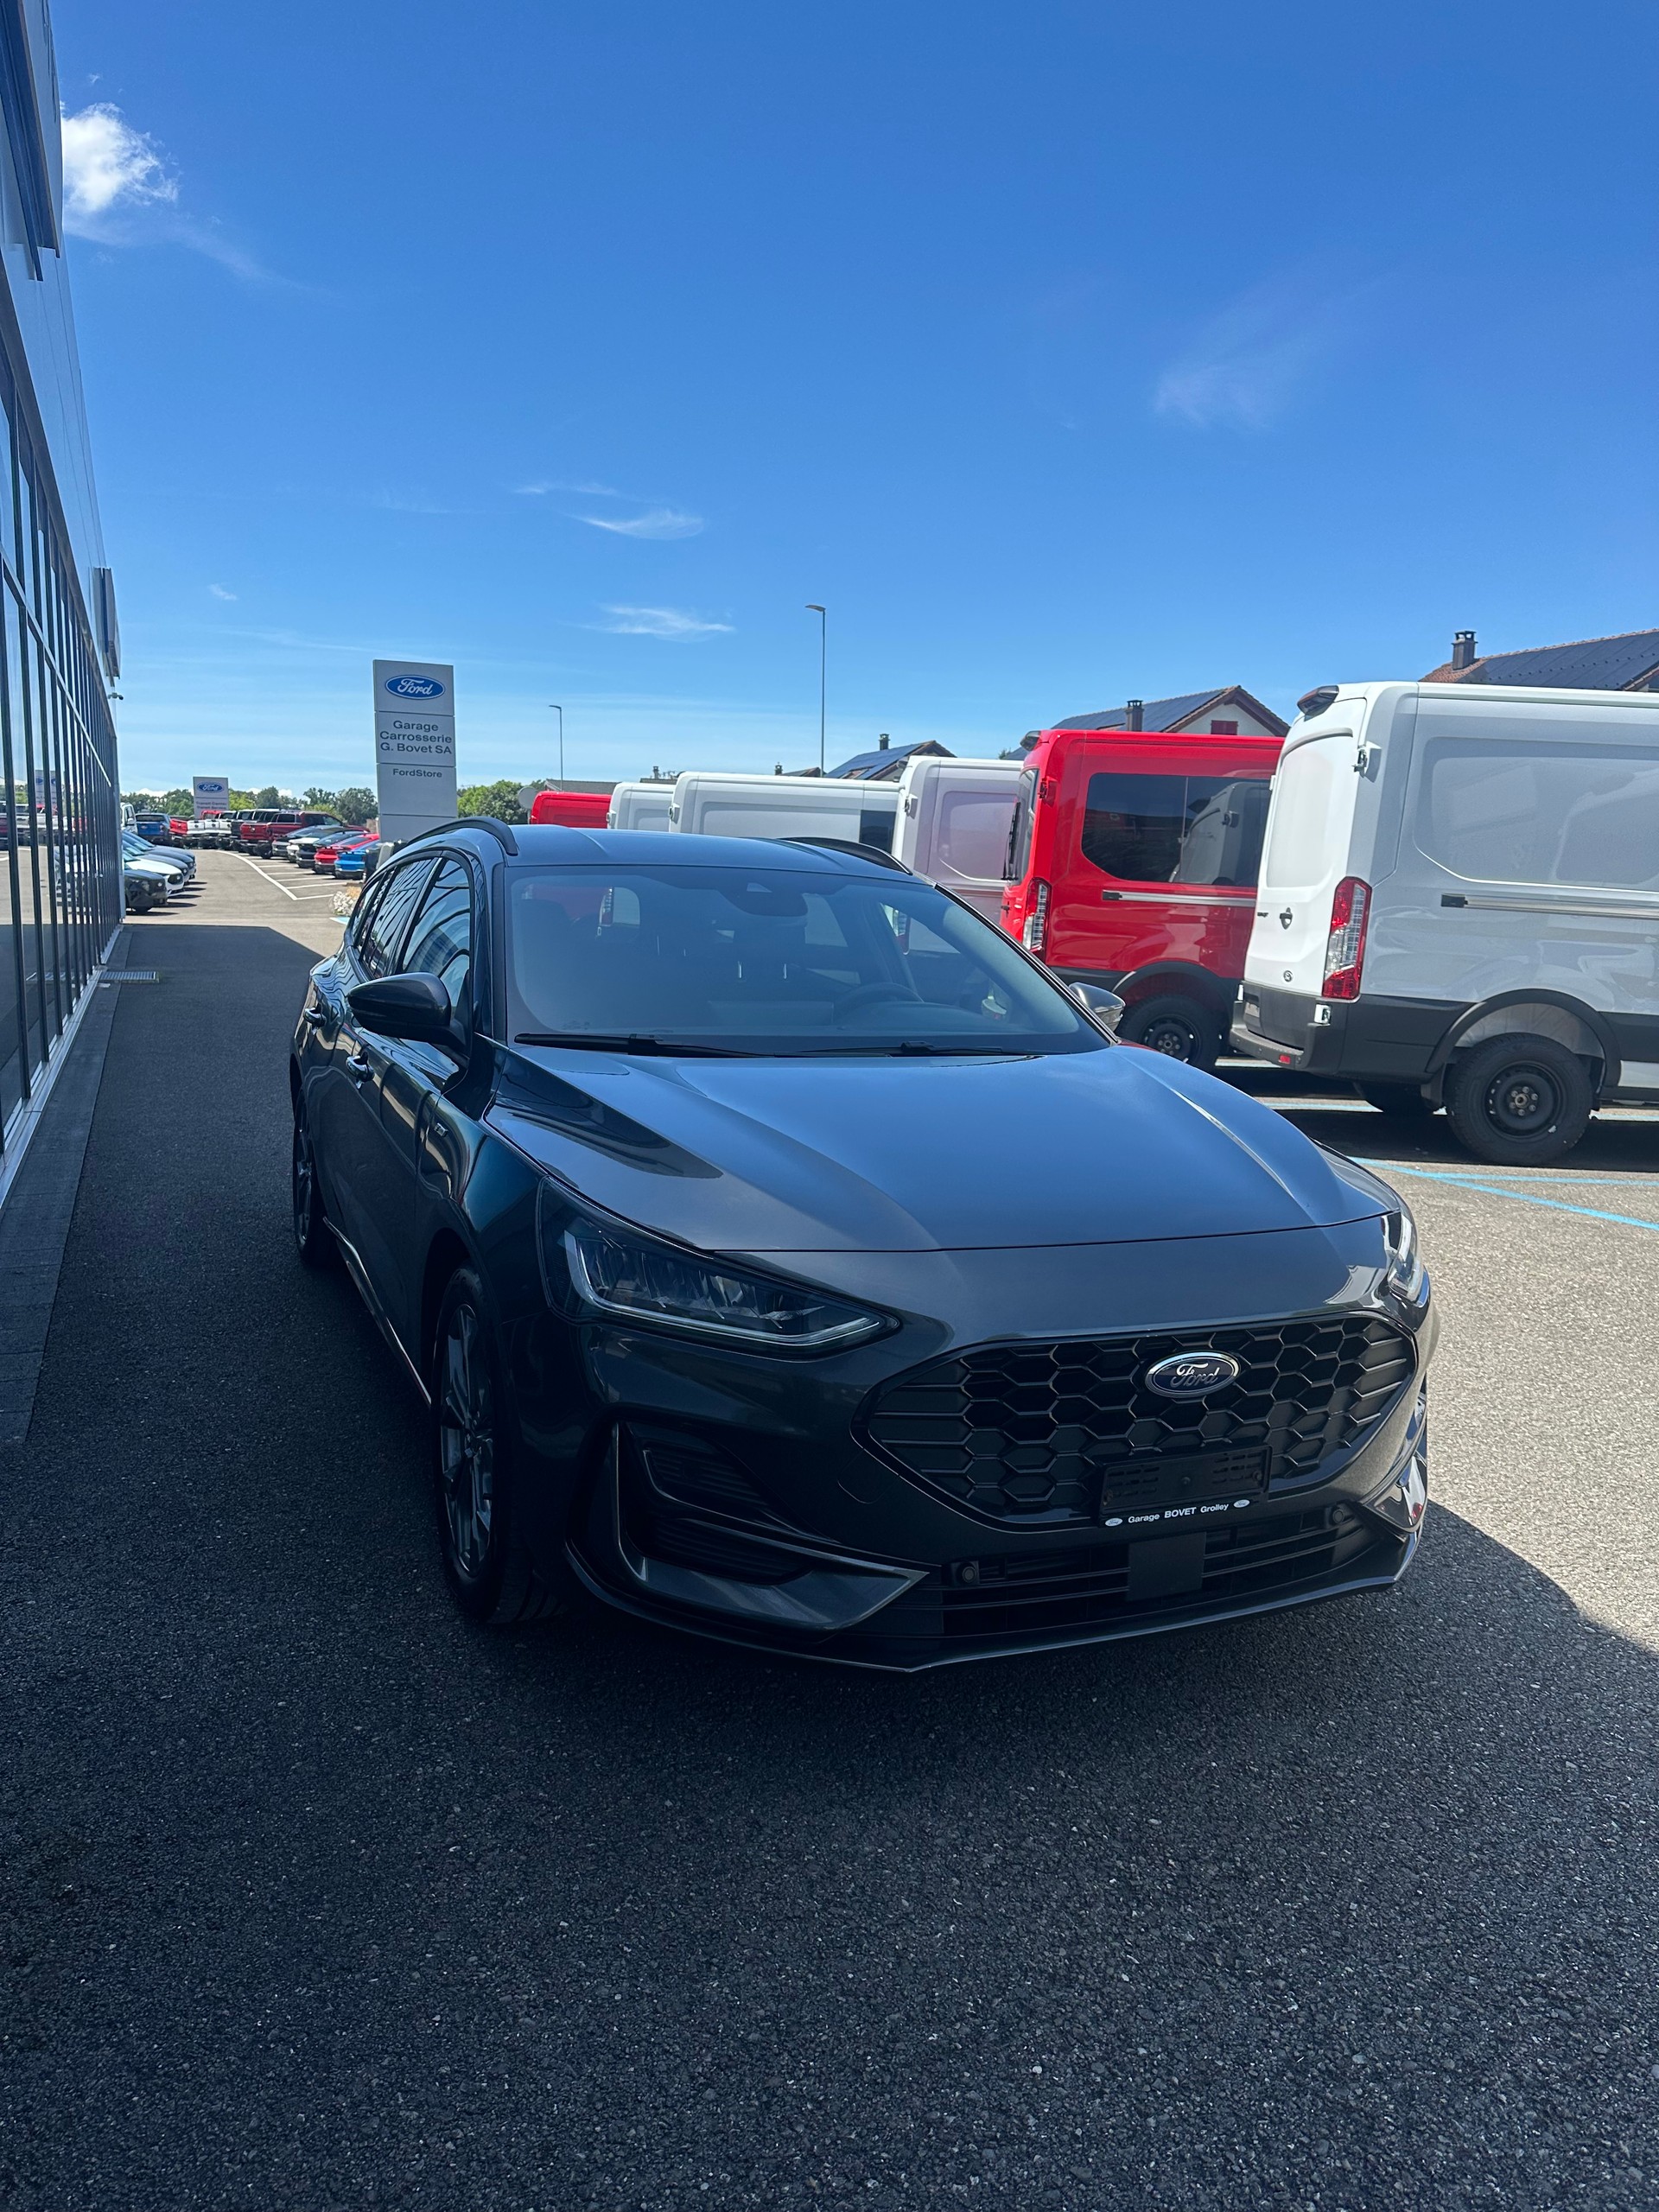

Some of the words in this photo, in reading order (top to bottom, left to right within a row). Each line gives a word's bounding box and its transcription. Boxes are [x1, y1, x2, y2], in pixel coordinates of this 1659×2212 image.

[397, 677, 433, 696] Ford
[393, 720, 439, 733] Garage
[379, 731, 452, 743] Carrosserie
[380, 742, 394, 751] G.
[397, 743, 432, 753] Bovet
[435, 745, 452, 754] SA
[392, 768, 442, 778] FordStore
[1170, 1362, 1220, 1388] Ford
[1128, 1514, 1160, 1523] Garage
[1164, 1507, 1197, 1518] BOVET
[1200, 1503, 1229, 1513] Grolley
